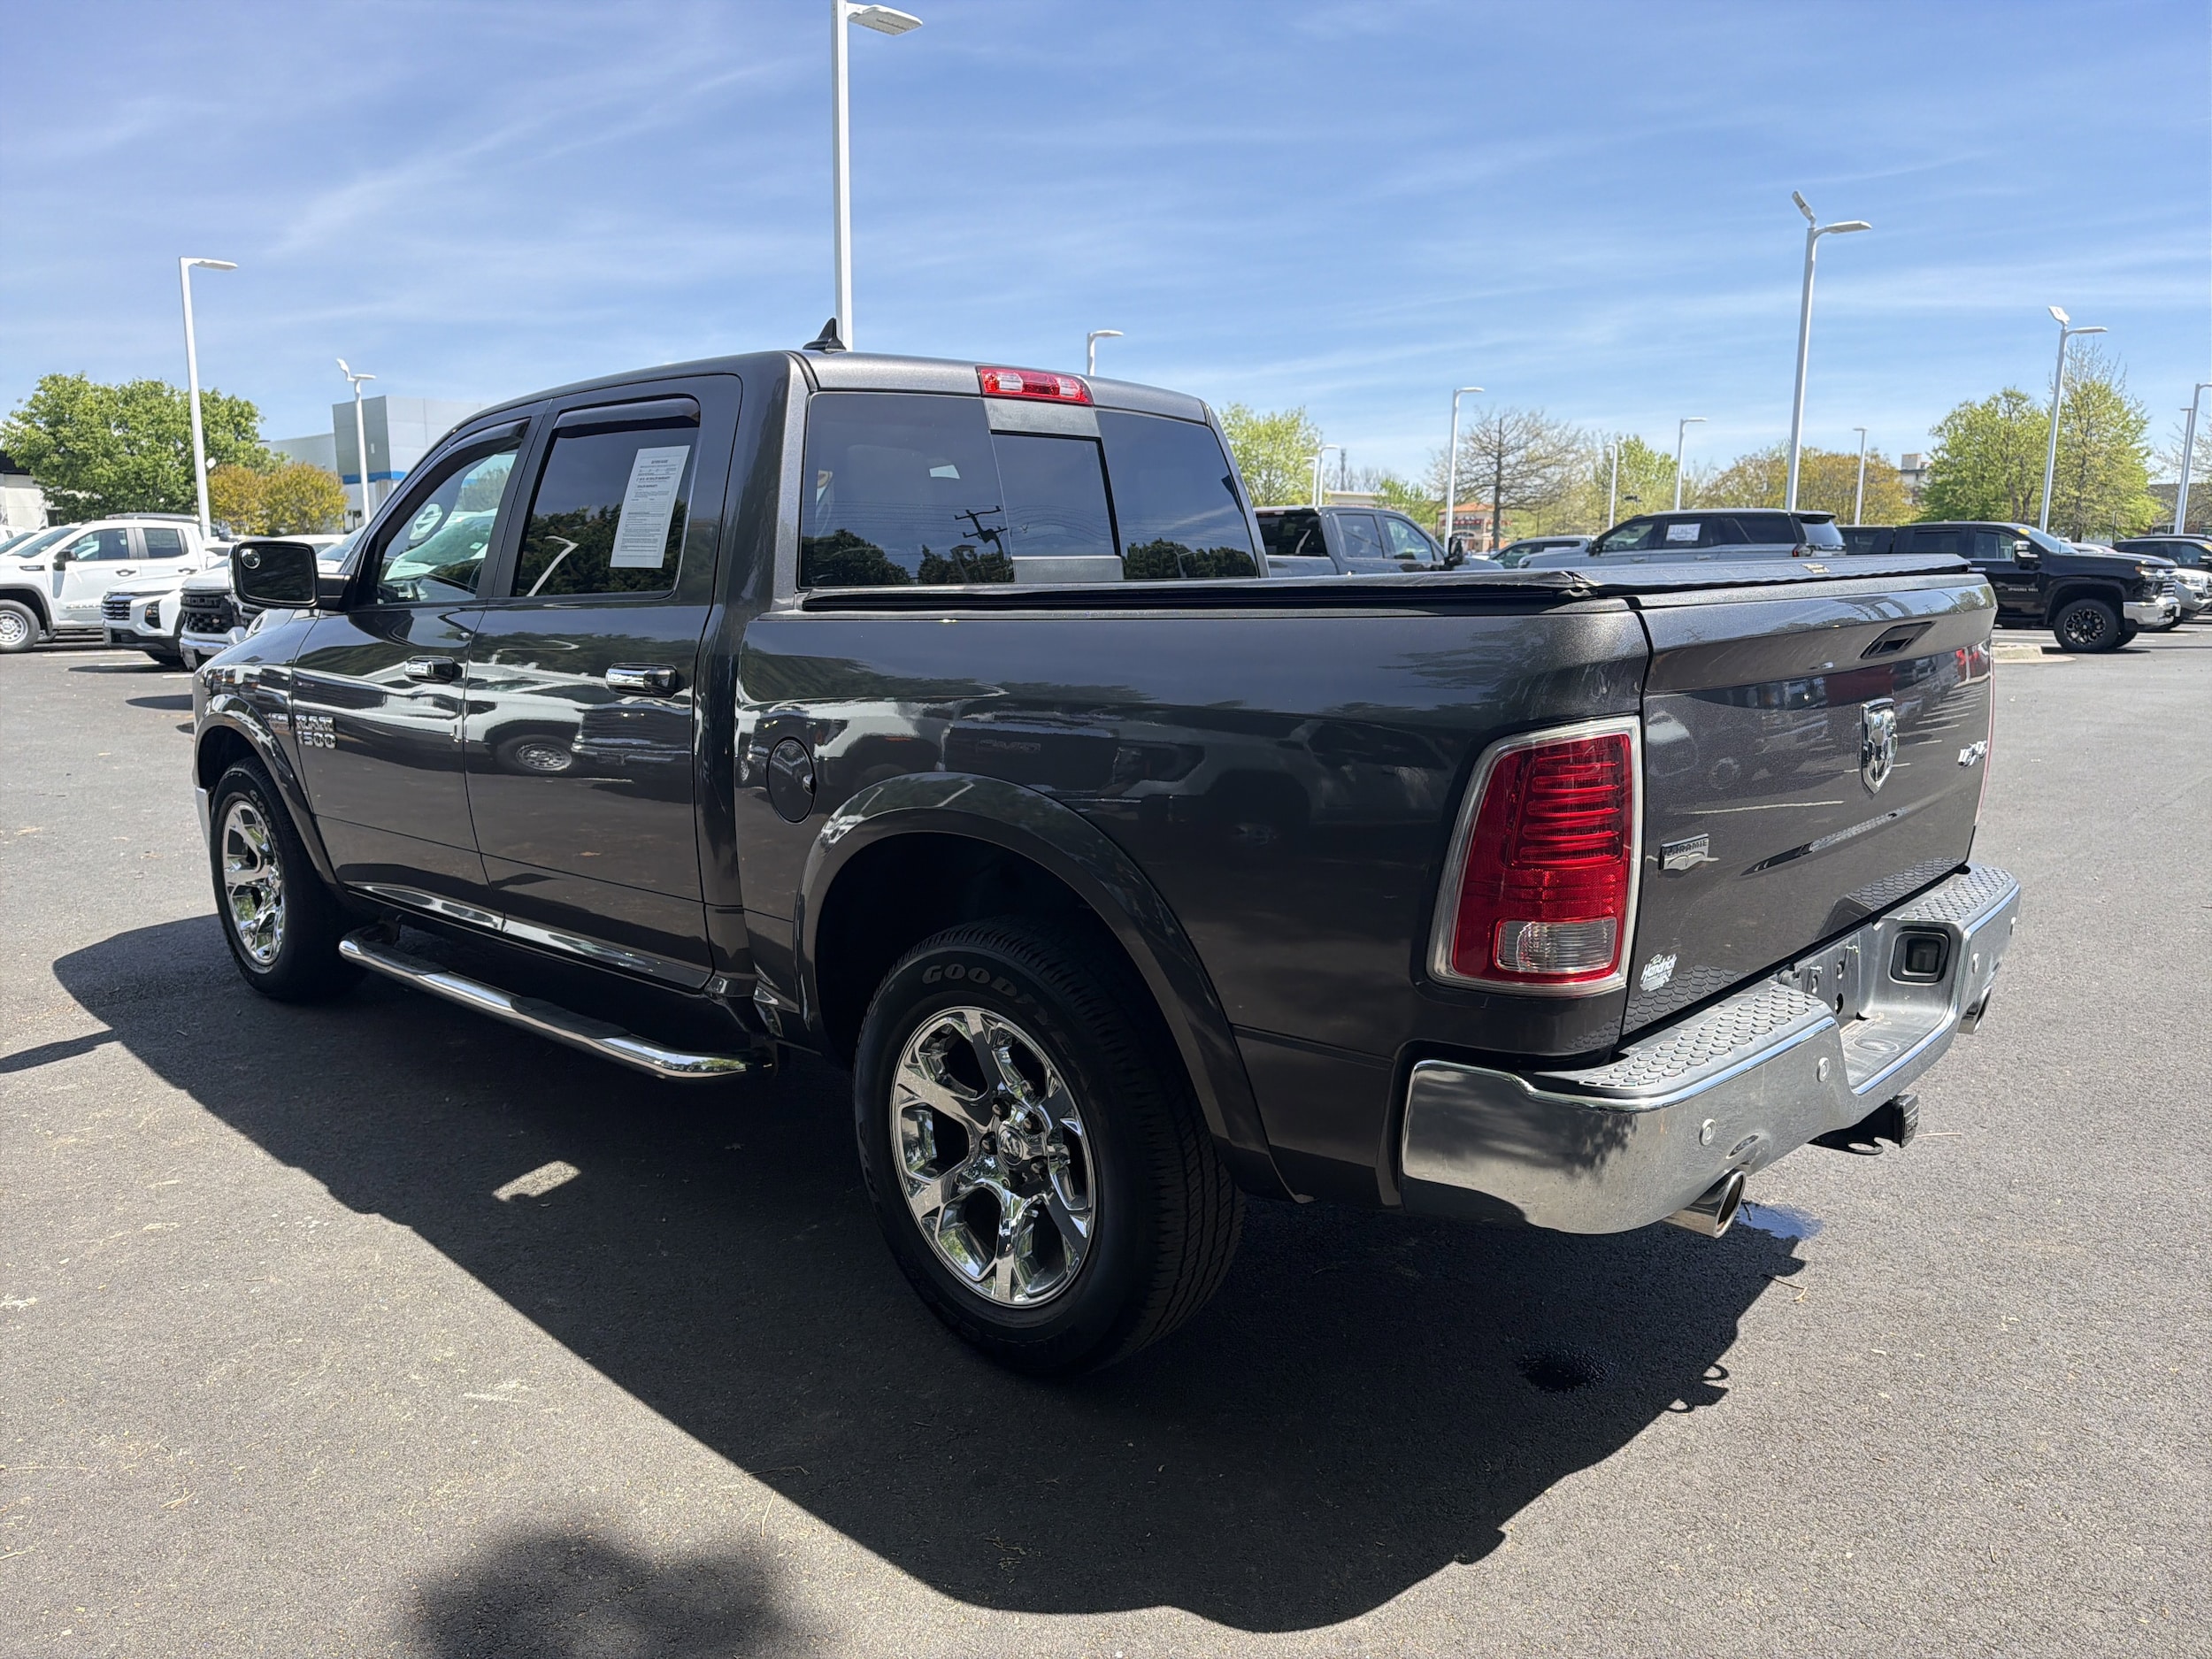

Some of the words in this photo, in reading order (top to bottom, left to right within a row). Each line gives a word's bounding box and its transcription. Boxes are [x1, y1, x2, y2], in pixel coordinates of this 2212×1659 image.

[296, 715, 334, 732] RAM
[297, 731, 336, 749] 1500
[1667, 839, 1709, 856] LARAMIE
